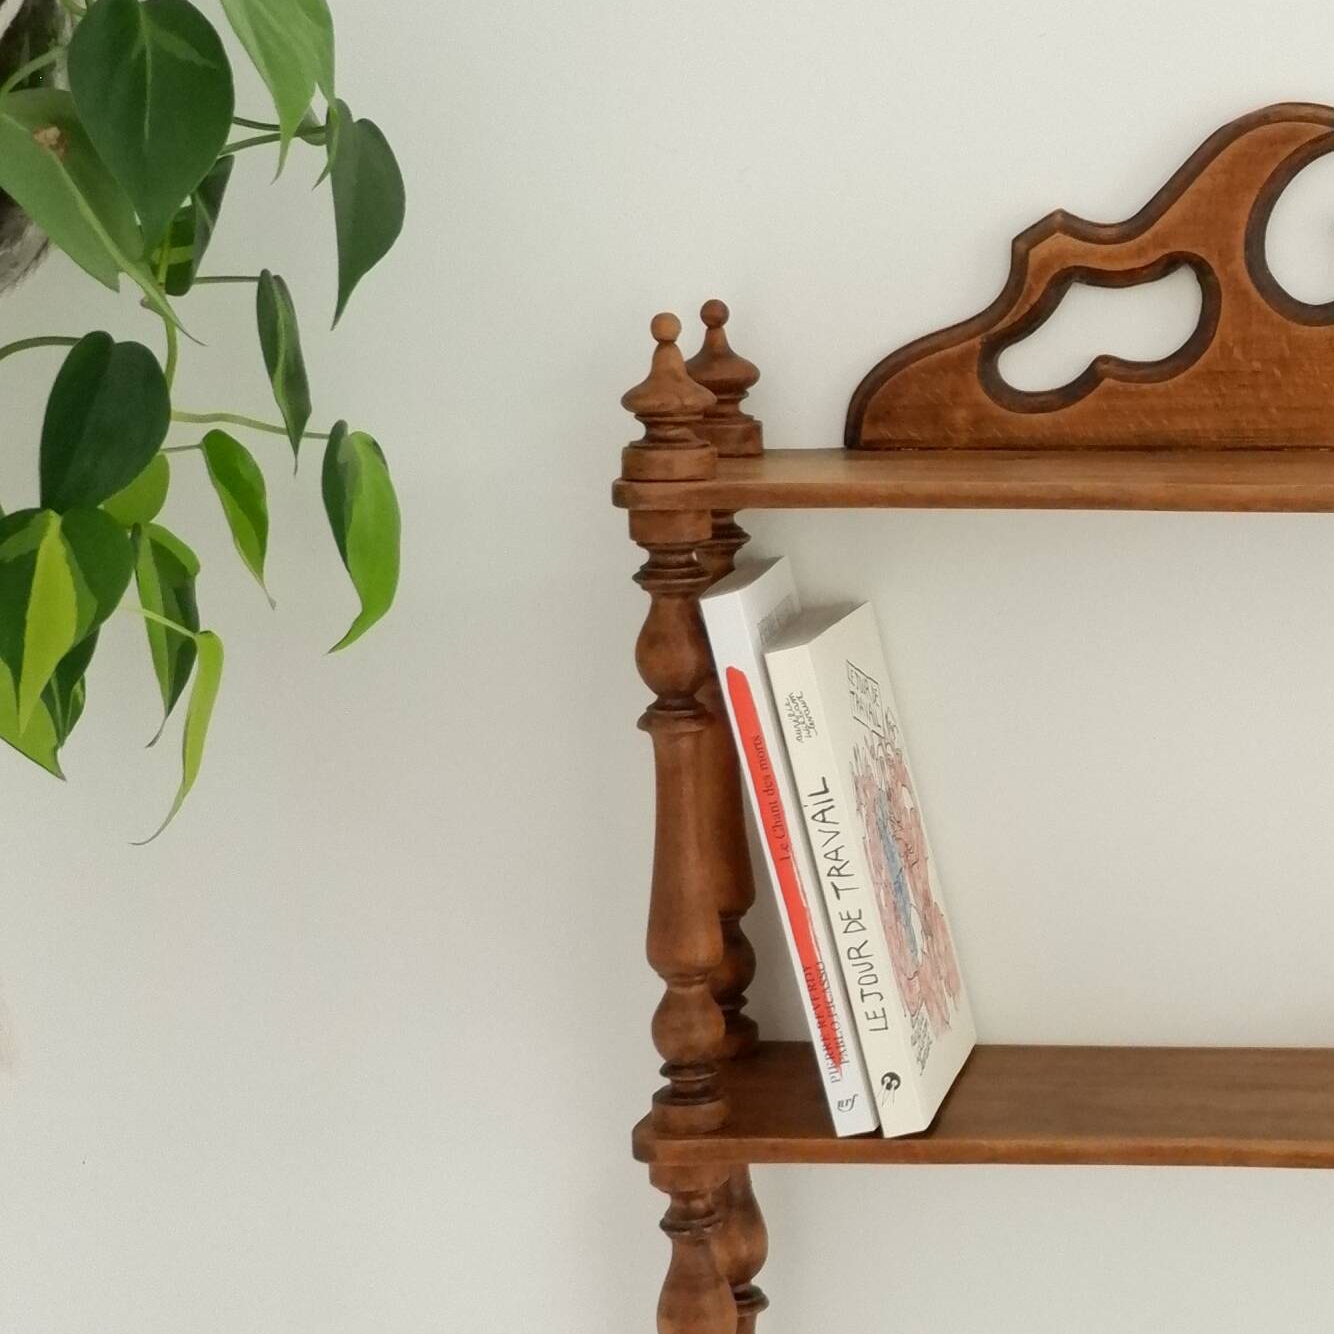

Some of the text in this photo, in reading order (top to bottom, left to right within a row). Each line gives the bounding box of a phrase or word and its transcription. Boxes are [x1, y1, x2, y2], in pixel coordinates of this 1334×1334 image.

[752, 734, 770, 770] morts
[768, 800, 787, 839] Chant
[803, 776, 889, 1032] LE JOUR DE TRAVAIL
[818, 1030, 841, 1084] PIERRE
